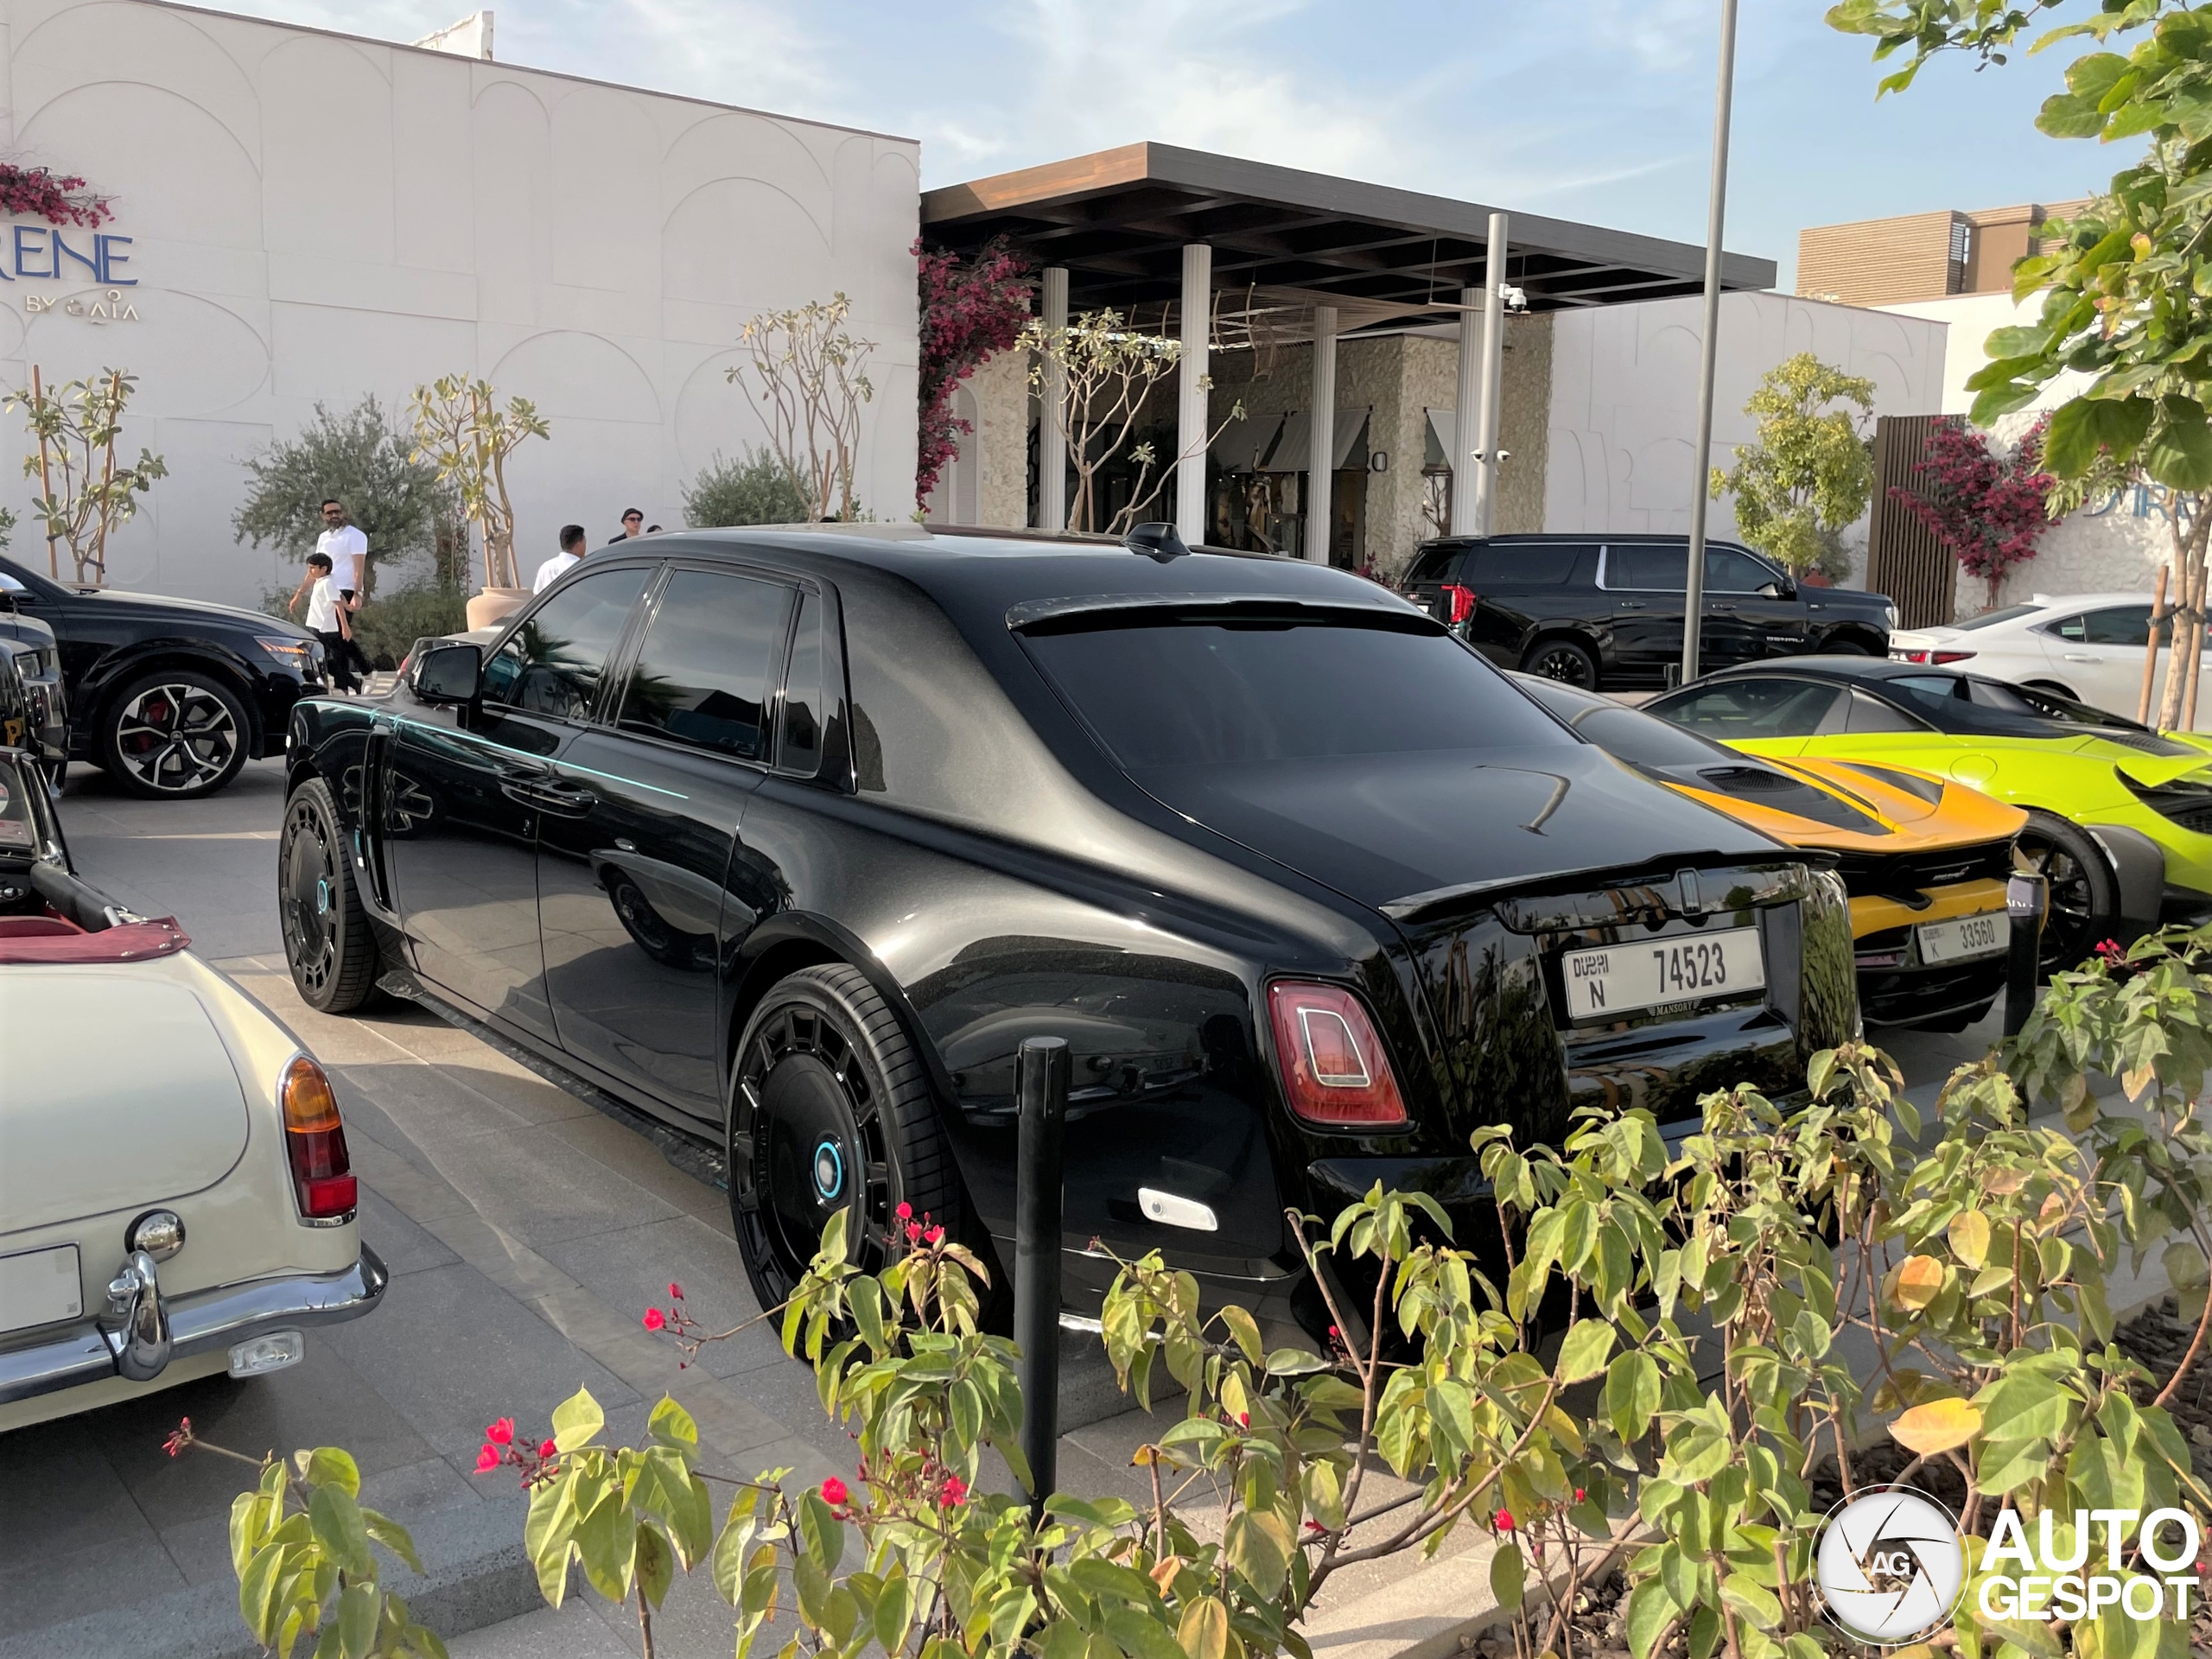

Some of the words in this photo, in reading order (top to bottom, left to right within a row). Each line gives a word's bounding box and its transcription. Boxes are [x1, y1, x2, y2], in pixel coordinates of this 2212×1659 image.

[26, 295, 56, 313] BY
[1960, 918, 1995, 950] 33560
[1929, 942, 1940, 959] K
[1653, 942, 1726, 994] 74523
[1589, 979, 1605, 1009] N
[1656, 1001, 1694, 1017] MANSORY
